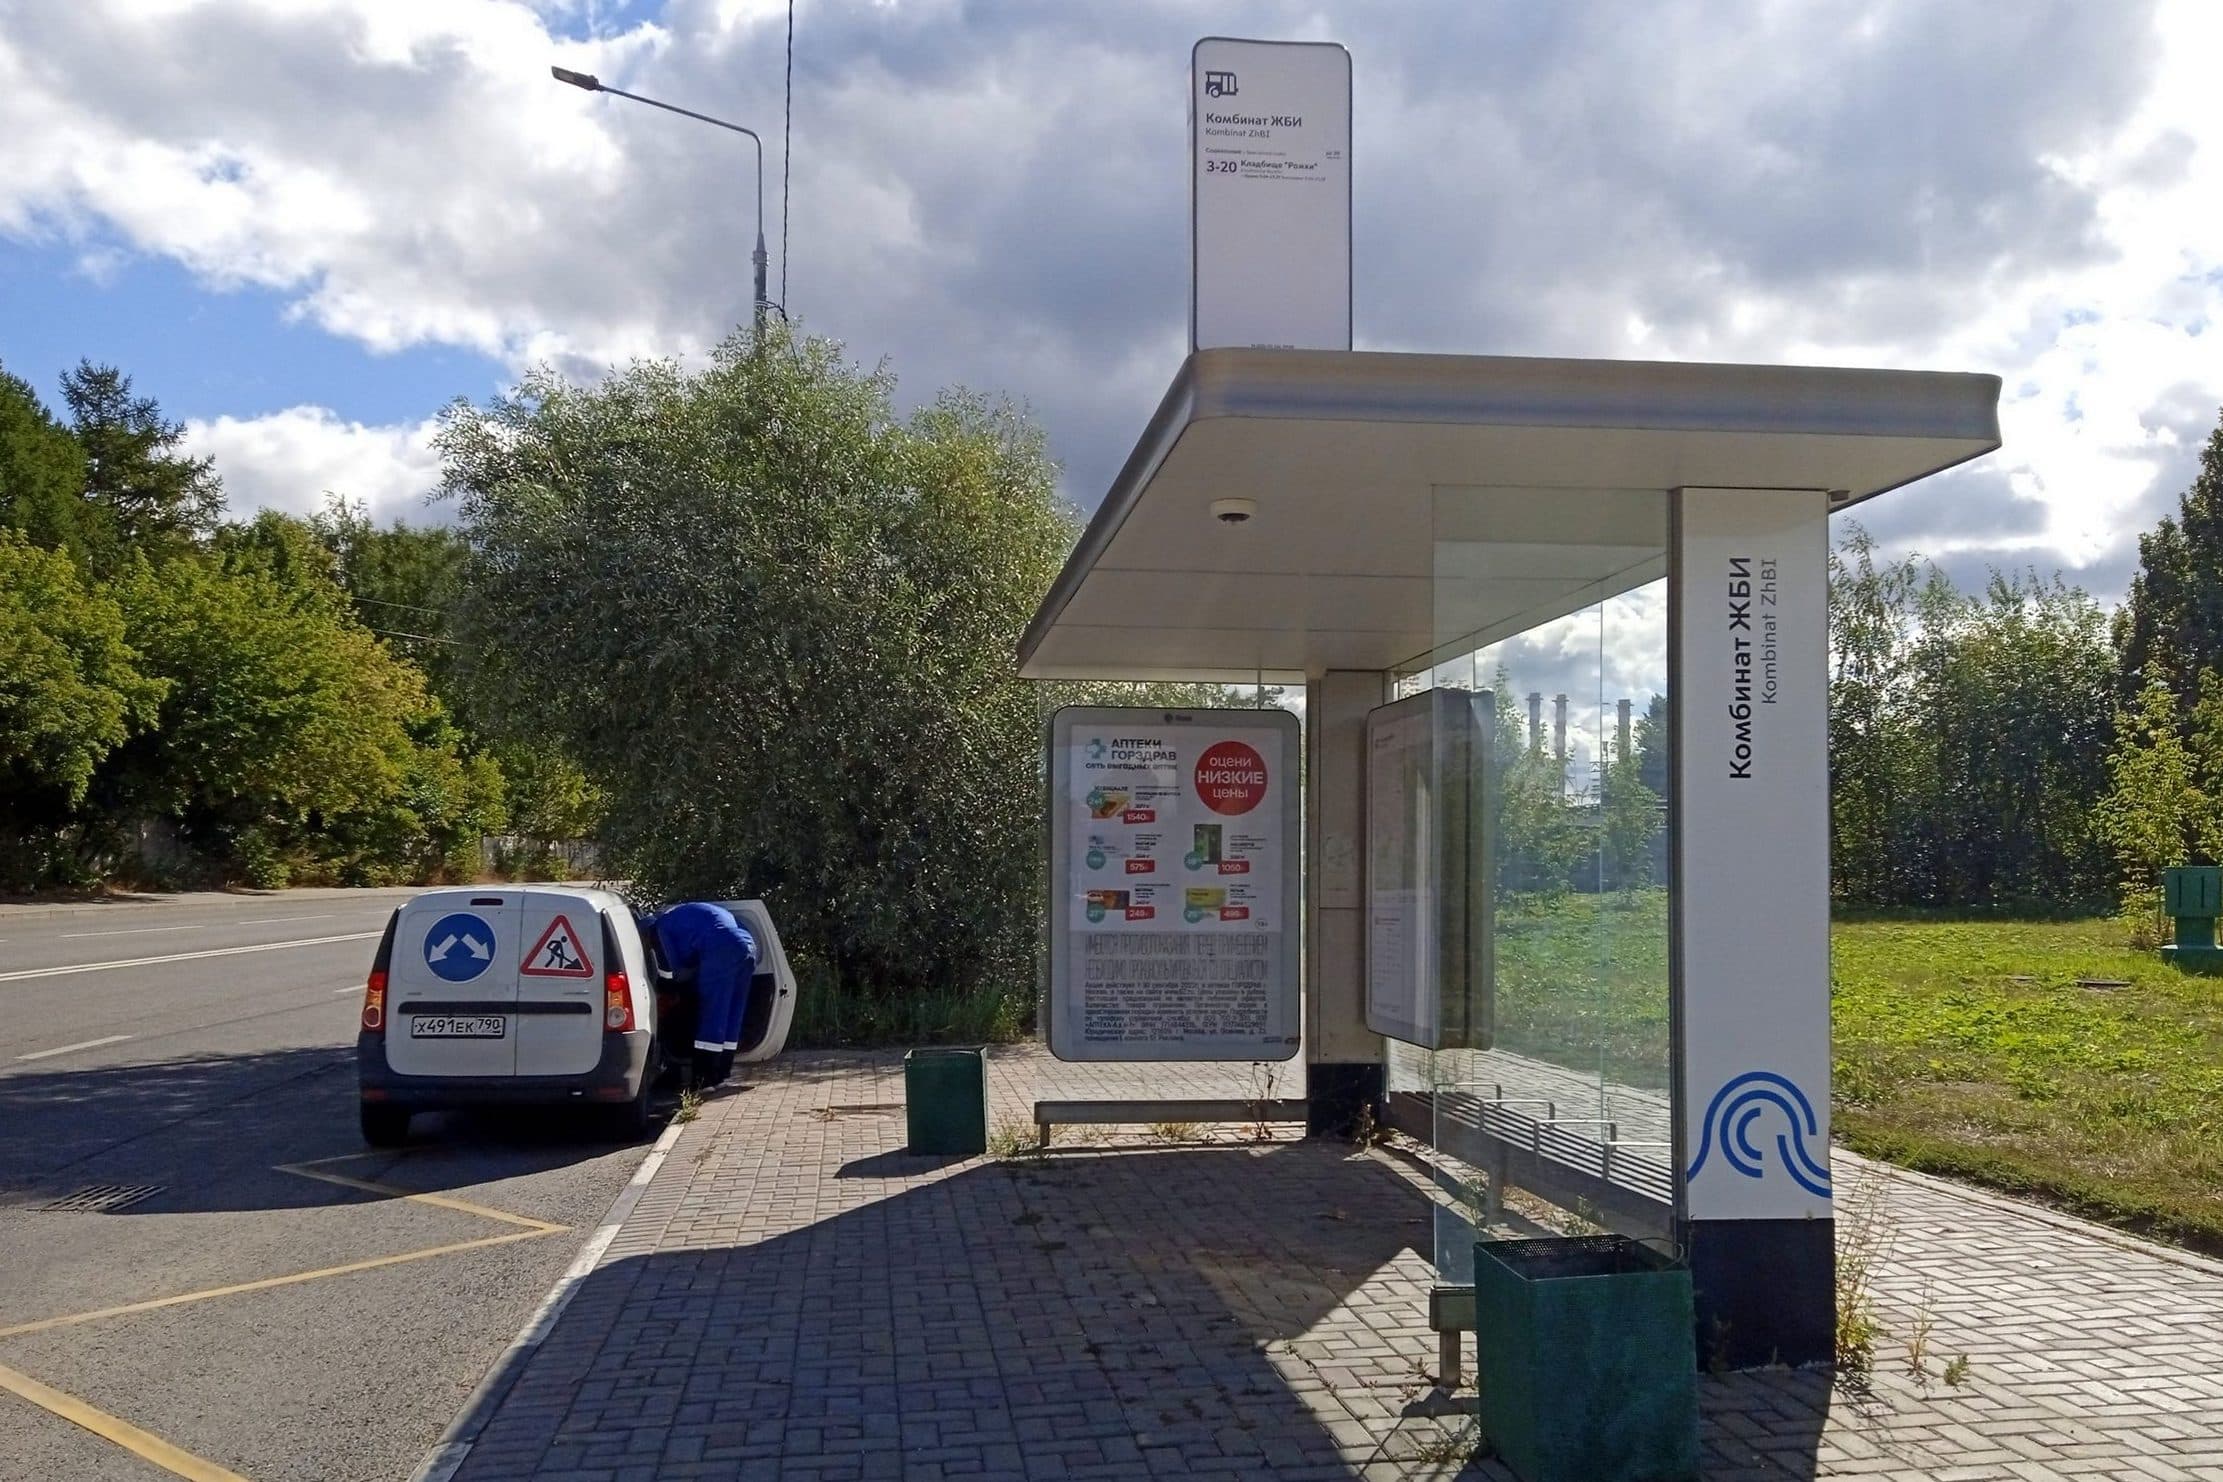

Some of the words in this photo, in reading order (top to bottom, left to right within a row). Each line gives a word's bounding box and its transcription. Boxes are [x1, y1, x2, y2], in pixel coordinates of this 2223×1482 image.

[1206, 113, 1268, 126] Комбинат
[1271, 116, 1302, 127] ЖБИ
[1205, 128, 1246, 137] Kombinat
[1249, 130, 1270, 139] ZhBI
[1206, 161, 1238, 173] 3-20
[1240, 160, 1283, 169] Кладбище
[1760, 559, 1777, 606] ZhBI
[1729, 557, 1751, 631] ЖБИ
[1760, 613, 1777, 704] Kombinat
[1728, 637, 1752, 778] Комбинат
[1111, 738, 1162, 749] АПТЕКИ
[1111, 751, 1177, 761] ГОРЗДРАВ
[1209, 757, 1252, 769] оцени
[1197, 770, 1264, 784] НИЗКИЕ
[1212, 787, 1249, 799] цены
[477, 1018, 501, 1030] 790
